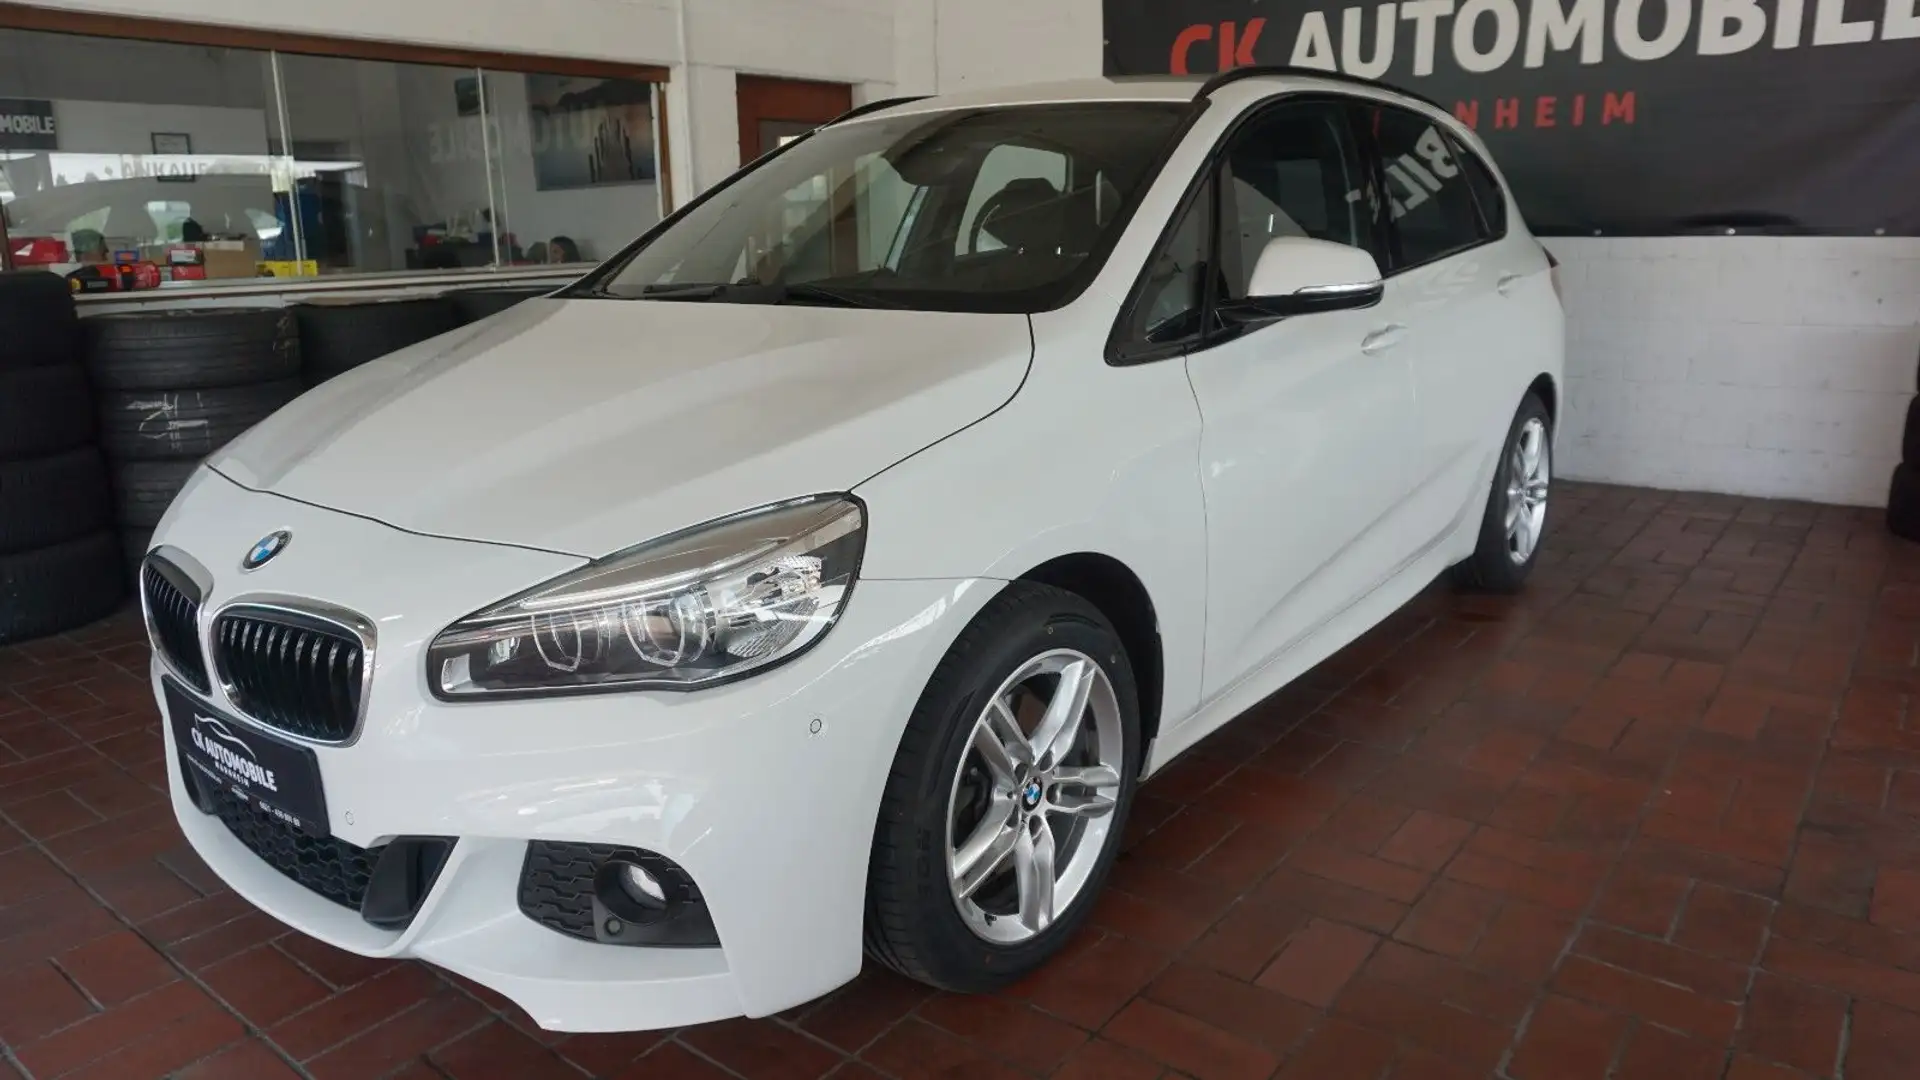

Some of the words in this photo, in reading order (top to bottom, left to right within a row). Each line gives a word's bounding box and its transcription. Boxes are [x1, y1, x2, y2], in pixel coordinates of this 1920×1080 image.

[1170, 17, 1267, 76] CK
[1455, 91, 1636, 133] NHEIM
[204, 736, 278, 792] AUTOMOBILE
